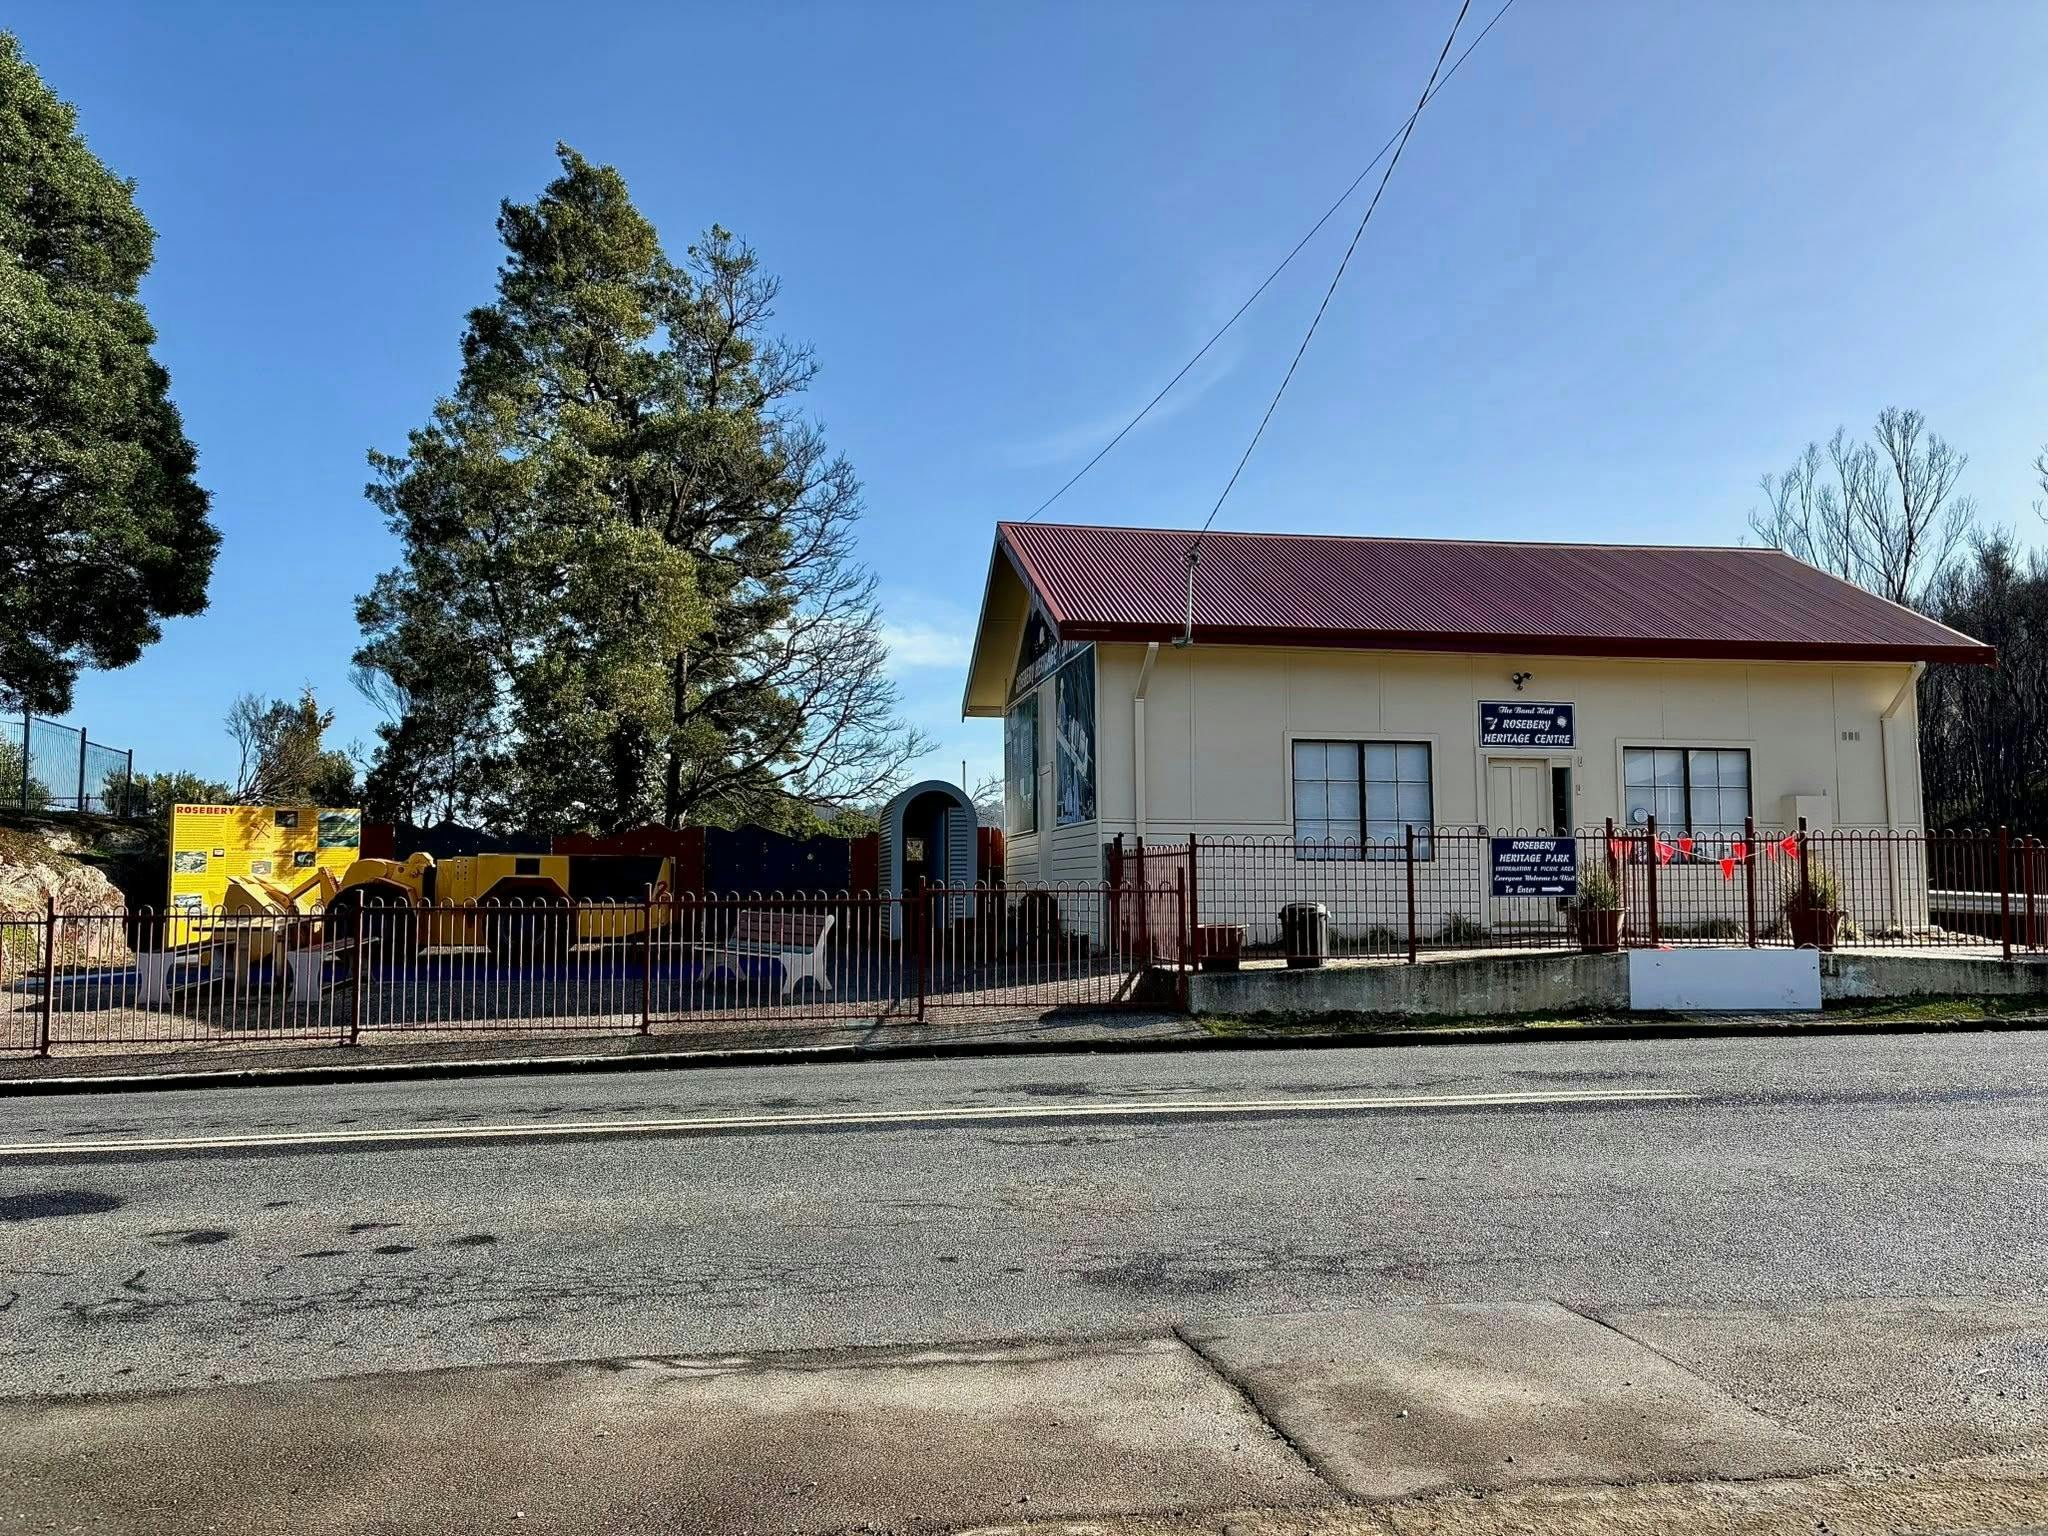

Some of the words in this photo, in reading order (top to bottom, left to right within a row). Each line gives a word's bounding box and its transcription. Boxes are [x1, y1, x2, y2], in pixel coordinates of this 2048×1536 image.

[1499, 705, 1513, 714] The
[1514, 706, 1536, 715] Band
[1536, 707, 1555, 715] Hall
[1502, 719, 1551, 731] ROSEBERY
[1483, 733, 1531, 744] HERITAGE
[1534, 734, 1571, 744] CENTRE
[176, 806, 235, 815] ROSEBERY
[1512, 841, 1556, 851] ROSEBERY
[1499, 853, 1542, 863] HERITAGE
[1545, 854, 1570, 863] PARK
[1505, 885, 1514, 894] To
[1517, 886, 1537, 894] Enter
